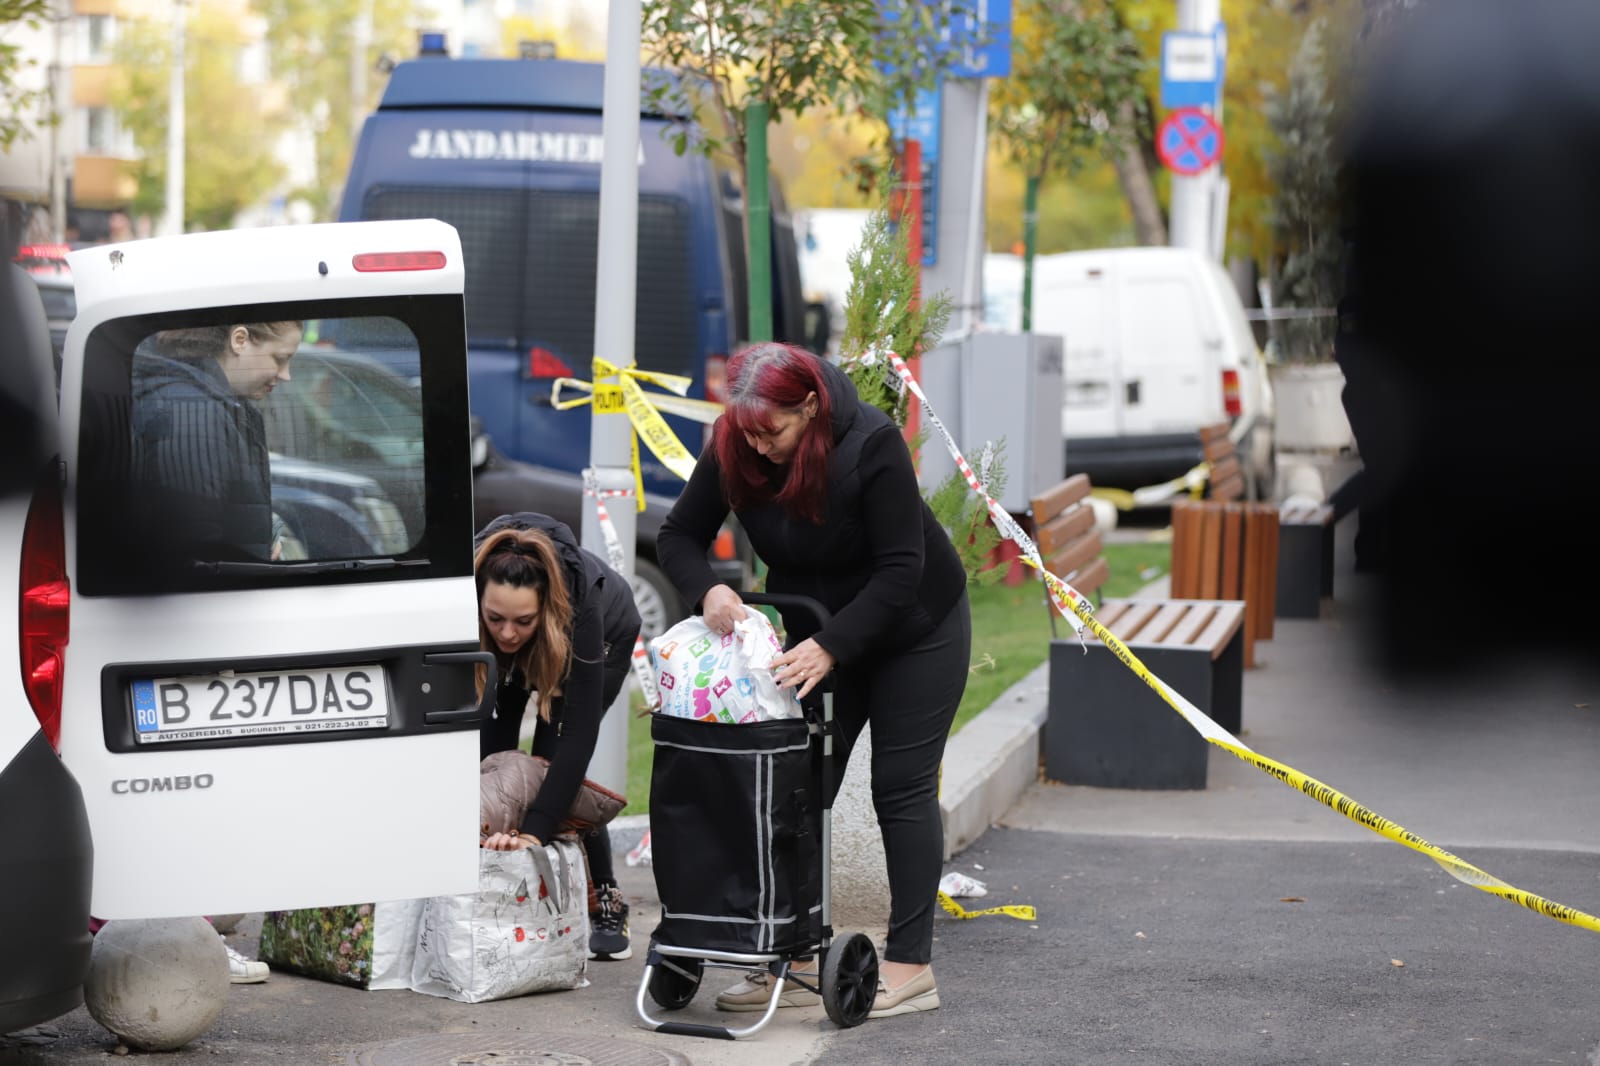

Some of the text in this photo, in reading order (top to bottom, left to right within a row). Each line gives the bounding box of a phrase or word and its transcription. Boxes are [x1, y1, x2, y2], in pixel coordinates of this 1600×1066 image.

[159, 671, 374, 725] B 237 DAS
[138, 709, 156, 726] RO
[158, 728, 233, 741] AUTOEREBUS
[111, 773, 214, 795] COMBO
